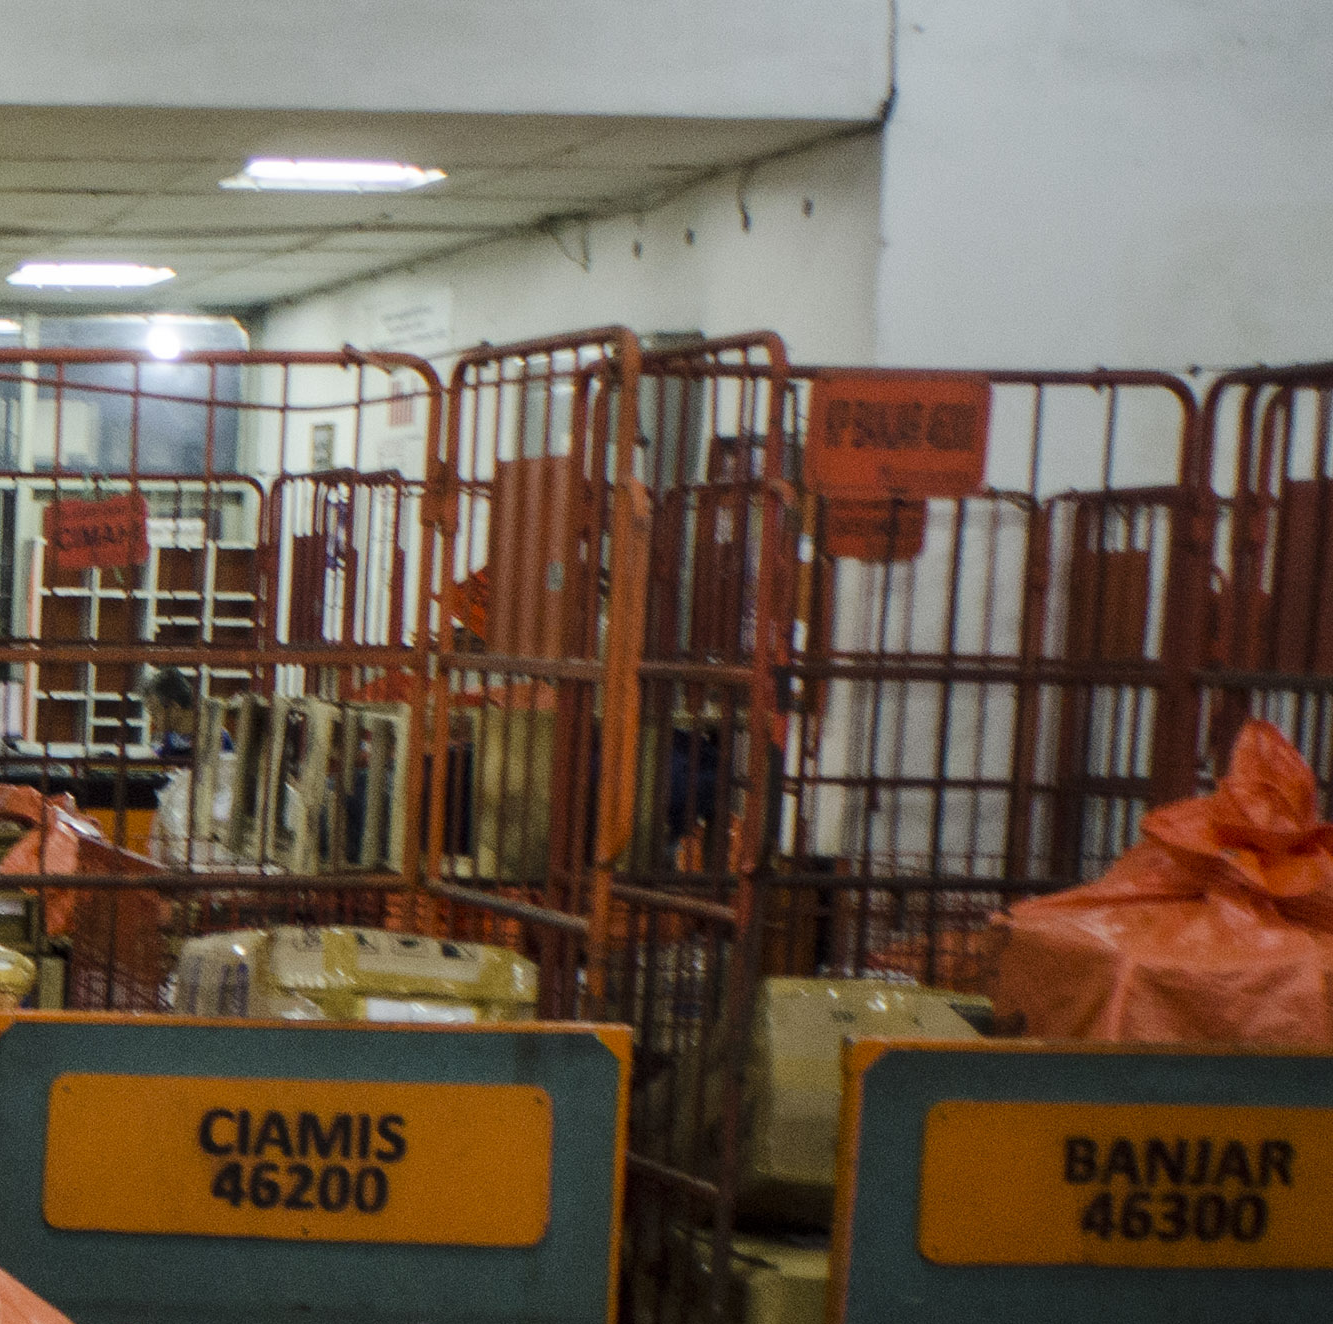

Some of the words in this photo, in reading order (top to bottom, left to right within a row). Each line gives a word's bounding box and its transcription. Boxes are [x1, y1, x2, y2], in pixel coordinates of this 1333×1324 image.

[197, 1108, 407, 1163] CIAMIS
[211, 1162, 389, 1214] 46200
[1063, 1136, 1296, 1189] BANJAR
[1080, 1192, 1267, 1243] 46300
